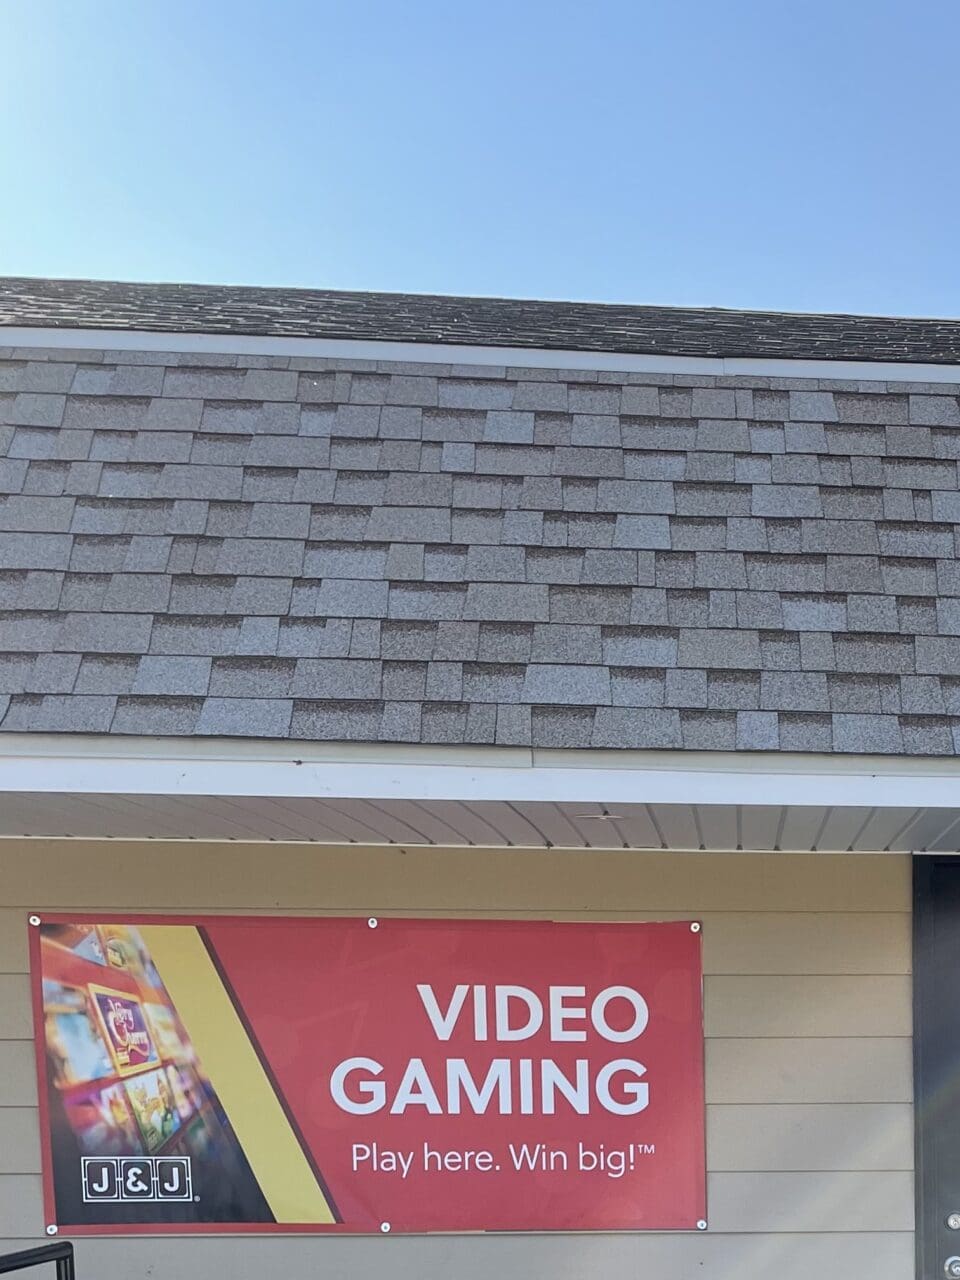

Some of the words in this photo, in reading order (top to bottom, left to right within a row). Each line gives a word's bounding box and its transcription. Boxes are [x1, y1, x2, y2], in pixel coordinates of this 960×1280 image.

[416, 984, 650, 1043] VIDEO
[329, 1057, 651, 1117] GAMING
[352, 1143, 414, 1178] Play
[424, 1143, 501, 1171] here.
[508, 1144, 569, 1171] Win
